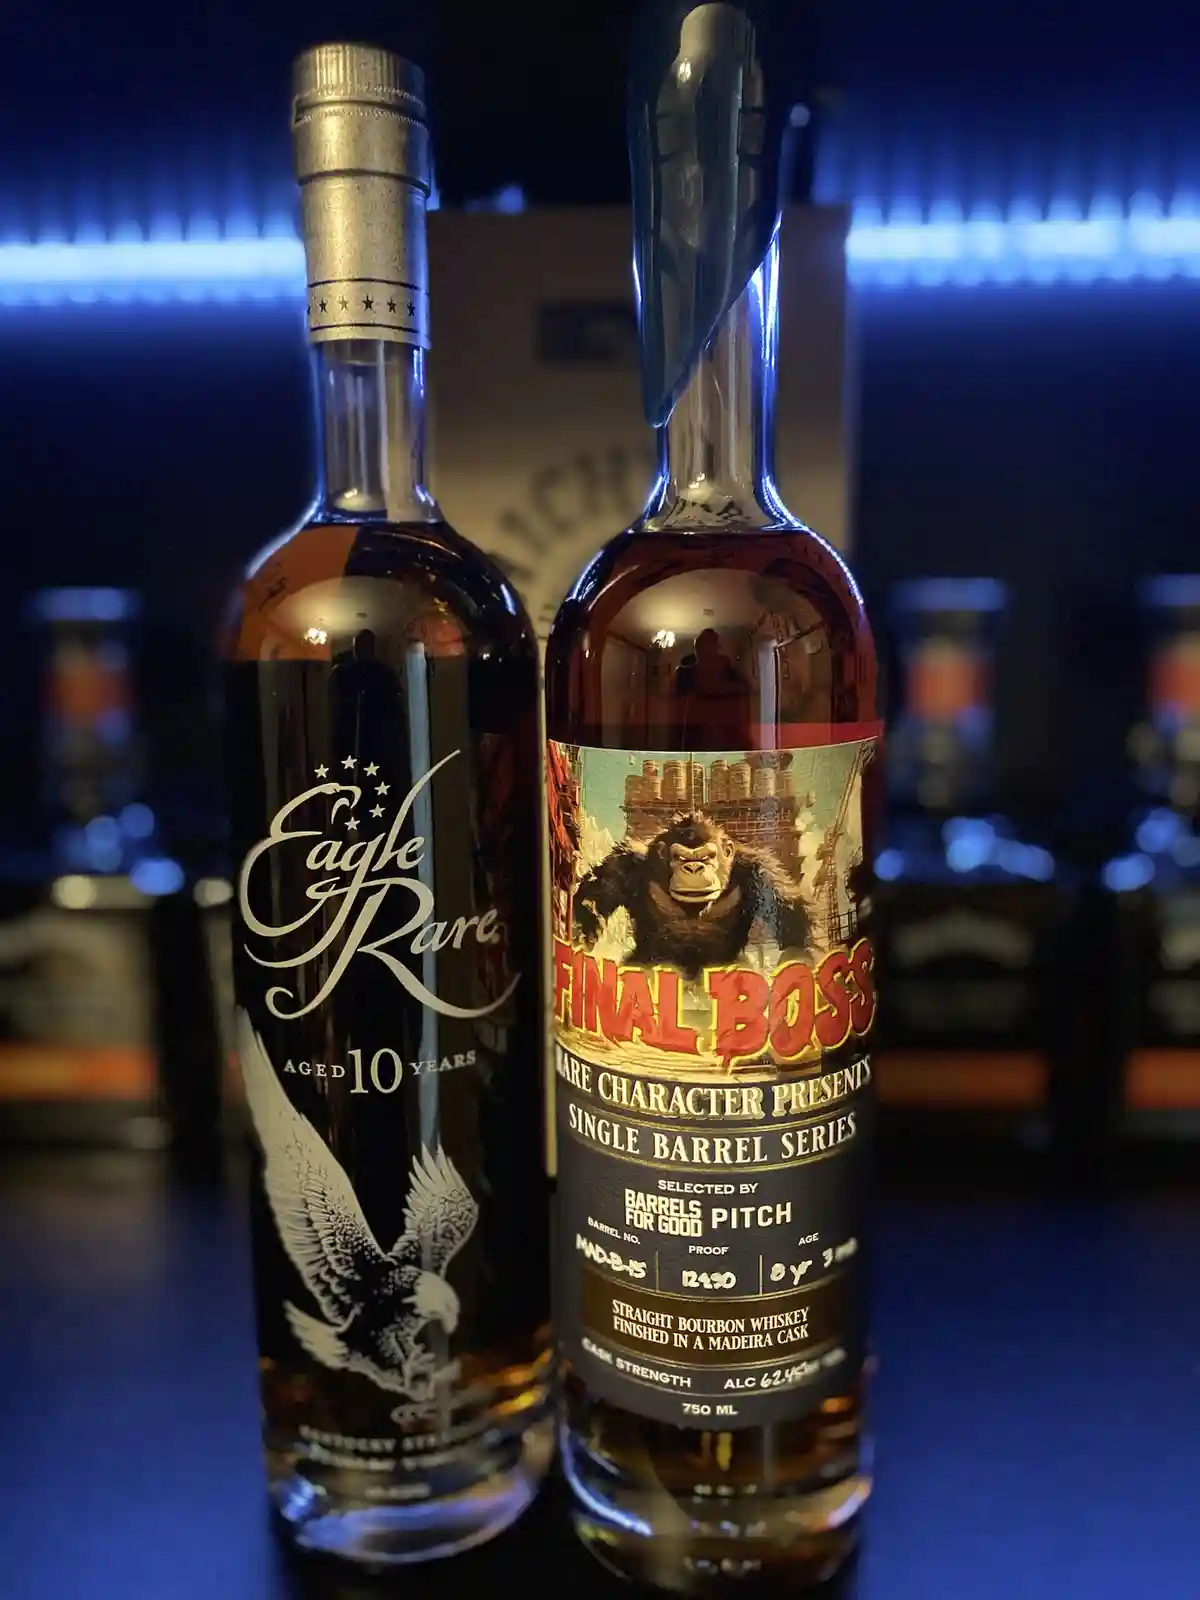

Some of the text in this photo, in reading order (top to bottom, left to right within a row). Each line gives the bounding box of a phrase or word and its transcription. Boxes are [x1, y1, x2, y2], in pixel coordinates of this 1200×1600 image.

[240, 749, 461, 968] Eagle
[265, 877, 522, 1020] Rare
[553, 934, 877, 1076] FINAL BOSS
[283, 1048, 476, 1094] AGED 10 YEARS
[598, 1072, 766, 1119] CHARACTER
[772, 1054, 872, 1117] PRESENTS
[569, 1103, 857, 1164] SINGLE BARREL SERIES
[658, 1179, 759, 1195] SELECTED BY
[624, 1188, 702, 1219] BARRELS
[711, 1202, 792, 1229] PITCH
[587, 1216, 641, 1245] BARREL NO.
[625, 1209, 702, 1237] FOR GOOD
[798, 1232, 819, 1246] AGE
[688, 1245, 730, 1256] PROOF
[612, 1300, 810, 1334] STRAIGHT BOURBON WHISKEY
[613, 1316, 810, 1351] FINISHED IN A MADEIRA CASK
[615, 1356, 692, 1389] STRENGTH
[723, 1377, 757, 1390] ALC
[682, 1402, 738, 1416] 750 ML
